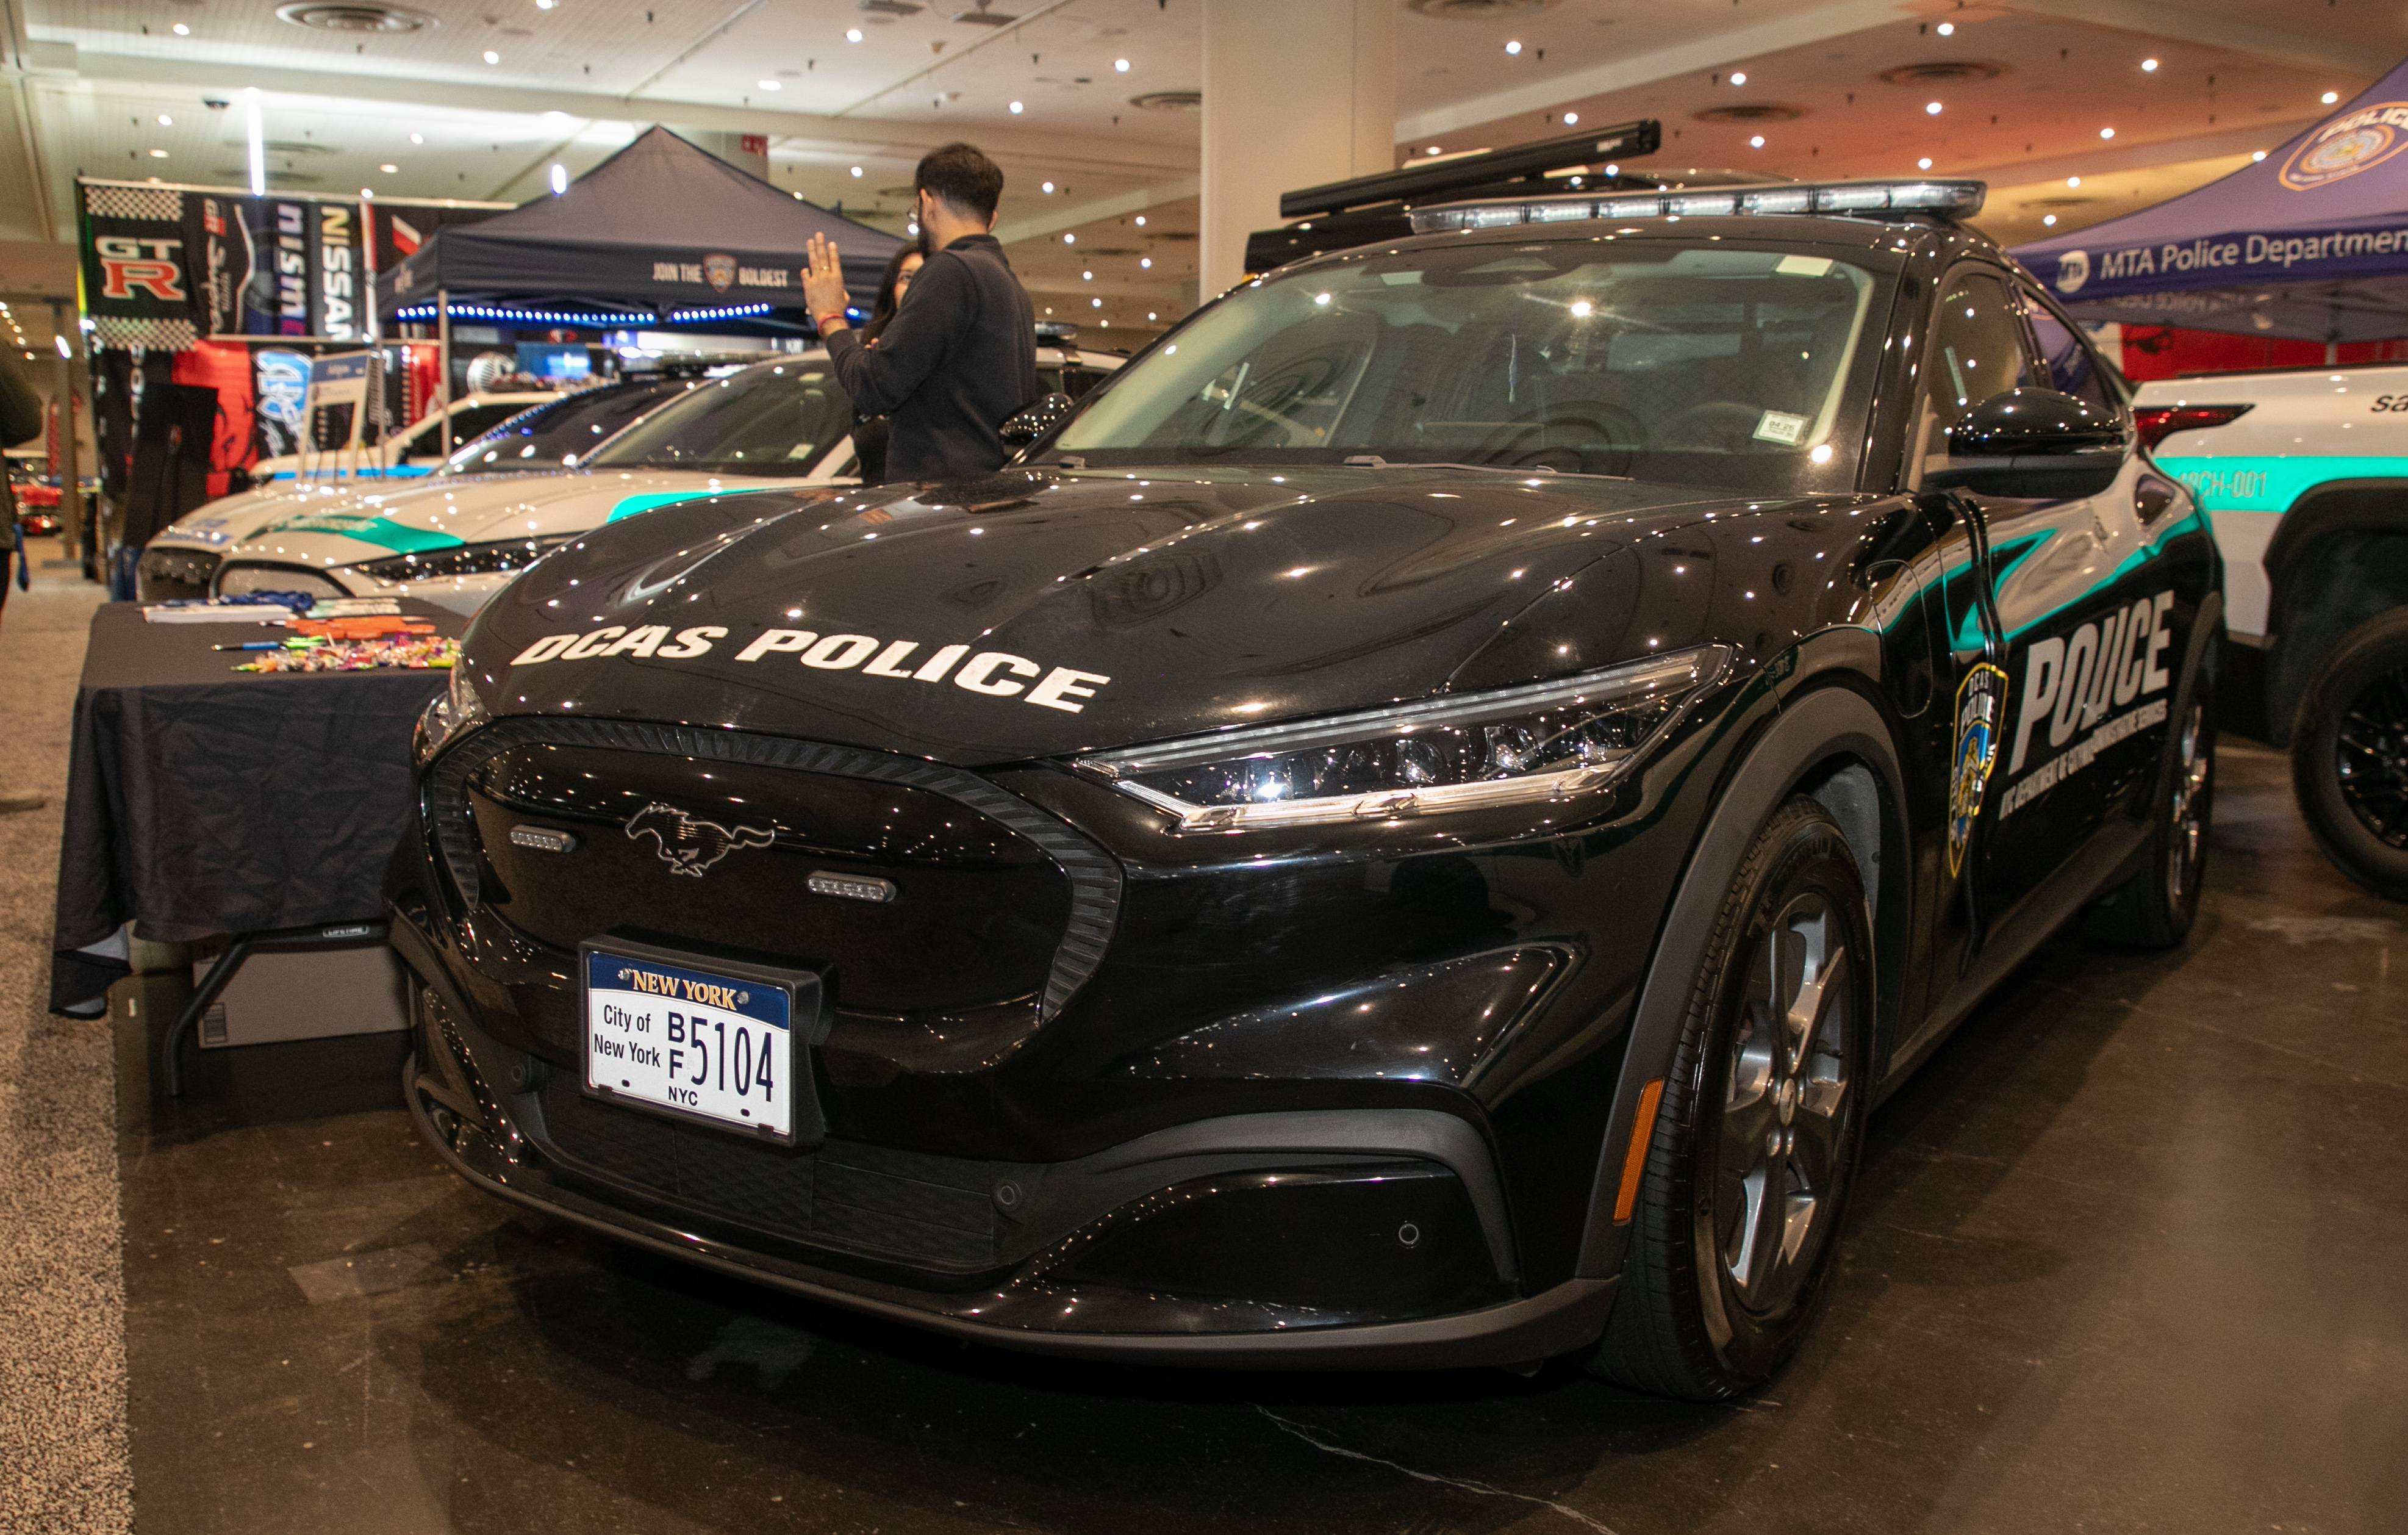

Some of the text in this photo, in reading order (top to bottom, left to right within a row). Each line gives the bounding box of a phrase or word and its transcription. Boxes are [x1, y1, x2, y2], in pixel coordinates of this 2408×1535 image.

[679, 263, 702, 283] THE
[2100, 249, 2155, 280] MTA
[2161, 240, 2240, 273] Police
[100, 257, 186, 301] R
[510, 625, 1110, 713] DCAS POLICE
[2008, 589, 2174, 775] POLICE
[632, 970, 736, 1010] NEW YORK
[603, 1004, 651, 1033] City of
[668, 1011, 685, 1043] B
[594, 1034, 661, 1068] New York
[669, 1048, 684, 1079] F
[690, 1016, 773, 1102] 5104
[668, 1085, 698, 1106] NYC
